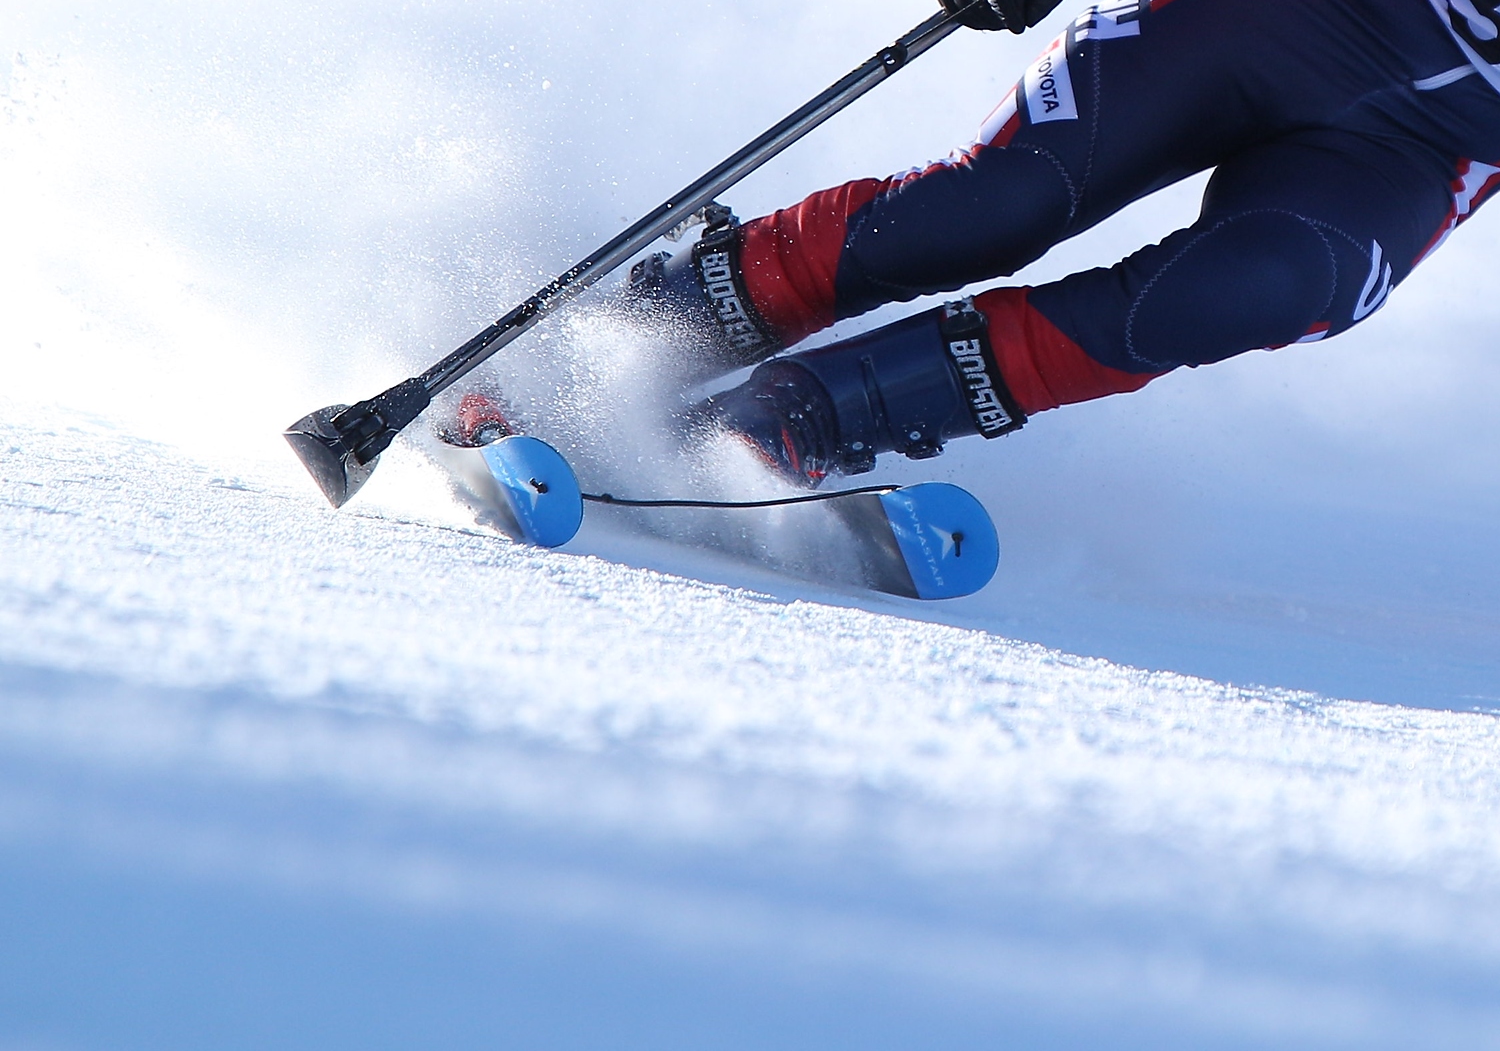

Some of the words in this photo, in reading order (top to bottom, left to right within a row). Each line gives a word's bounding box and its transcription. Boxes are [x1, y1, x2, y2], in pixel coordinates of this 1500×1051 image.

[1038, 55, 1060, 114] TOYOTA
[949, 338, 1013, 432] BOOSTER
[903, 500, 945, 587] DYNASTAR
